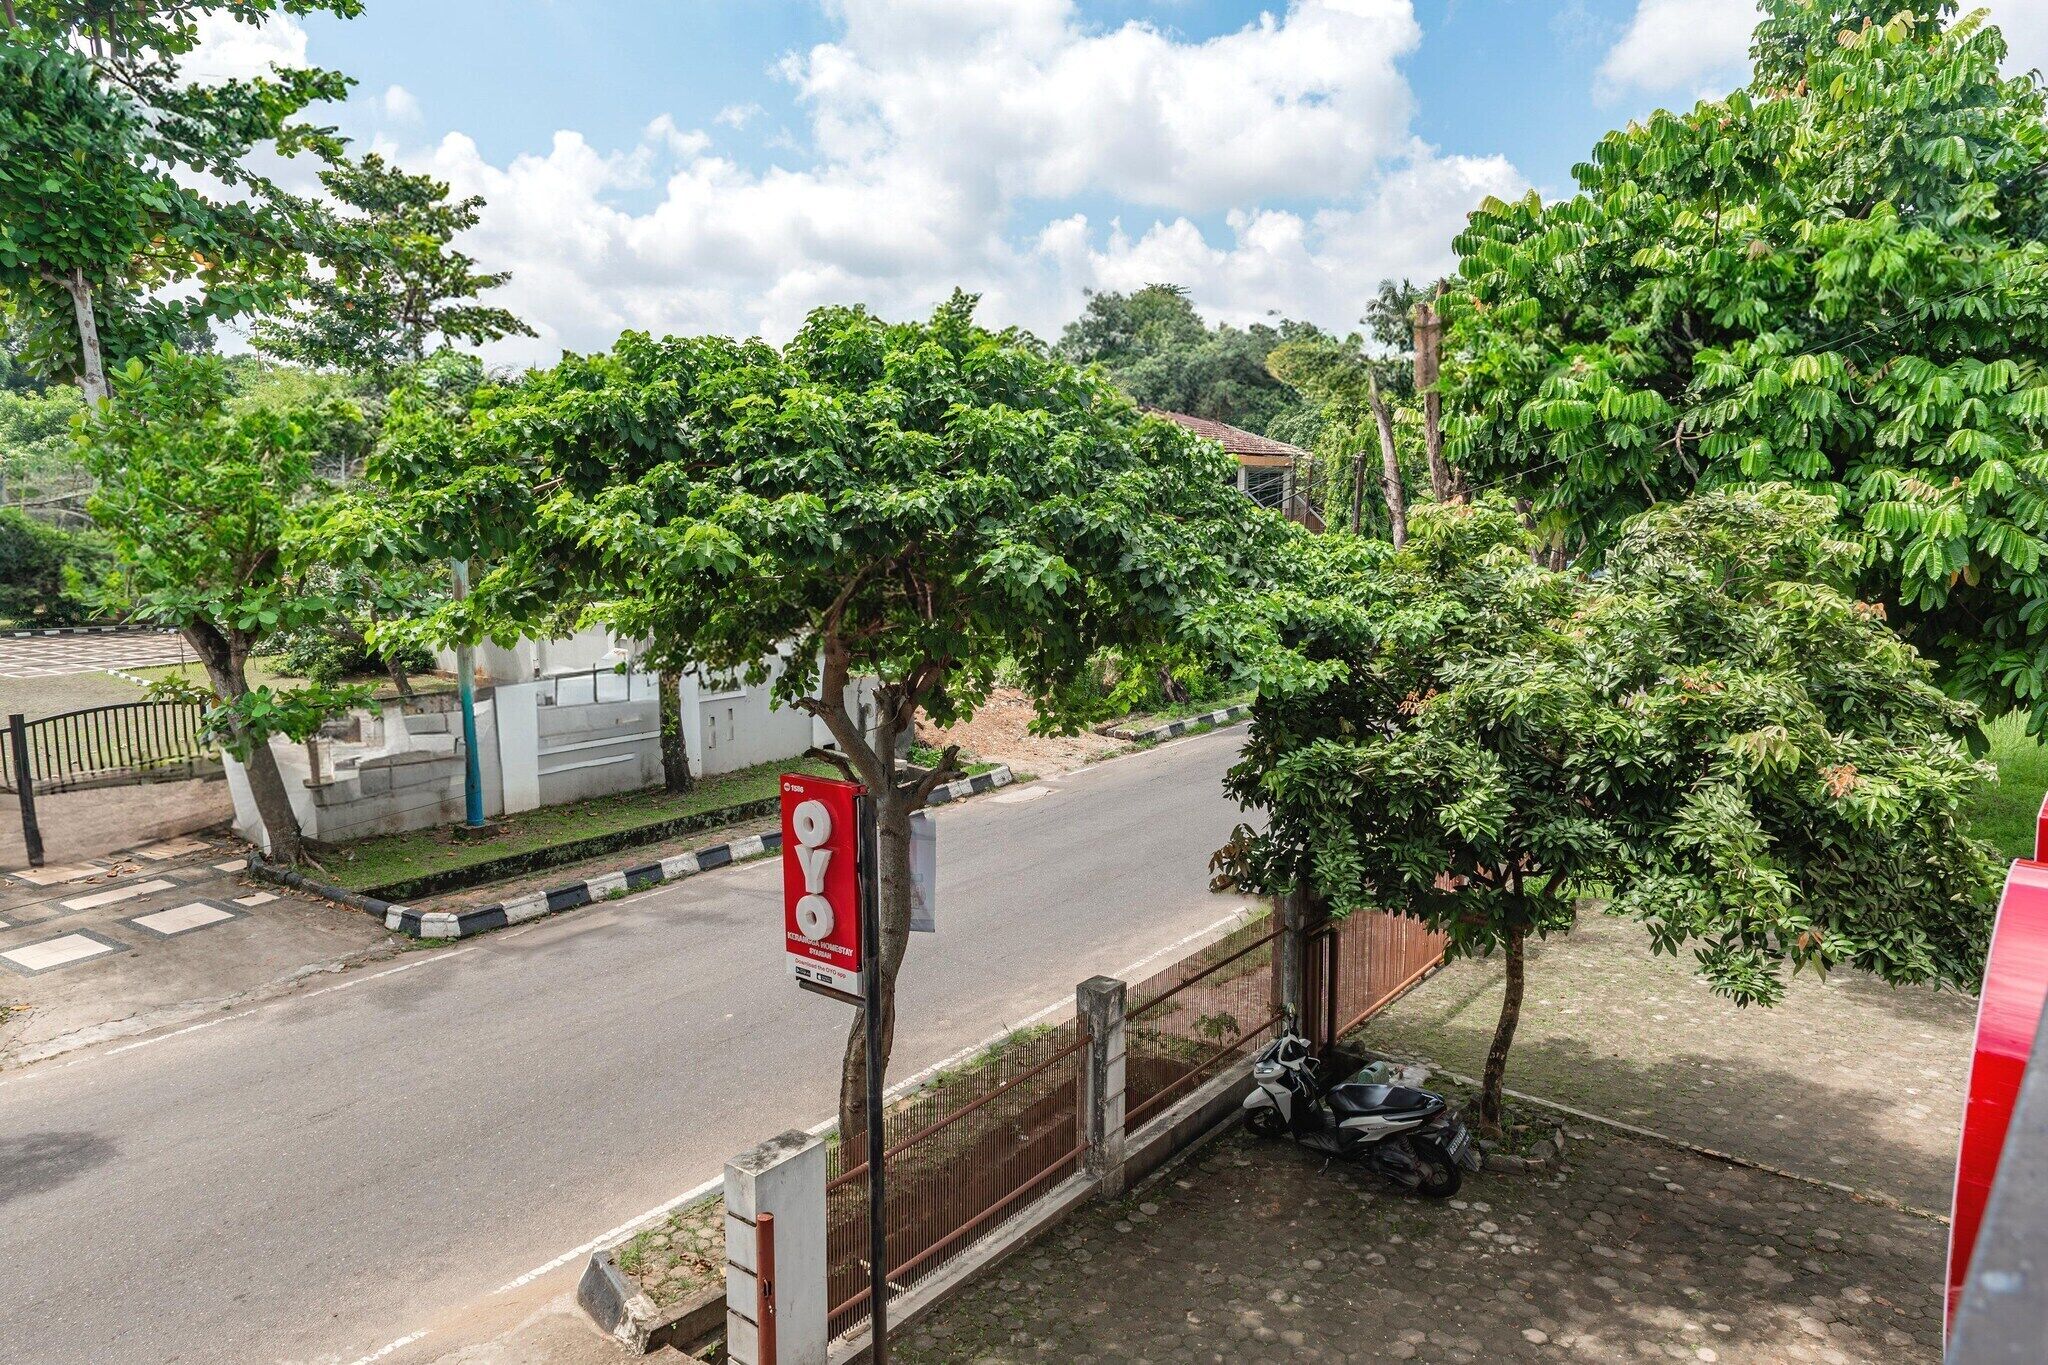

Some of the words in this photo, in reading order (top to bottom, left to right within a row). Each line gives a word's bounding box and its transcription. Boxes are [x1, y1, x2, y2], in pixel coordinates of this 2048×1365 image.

[793, 799, 834, 941] OYO
[820, 941, 853, 957] HOMESTAY
[795, 958, 817, 968] Download
[826, 967, 836, 975] OYO
